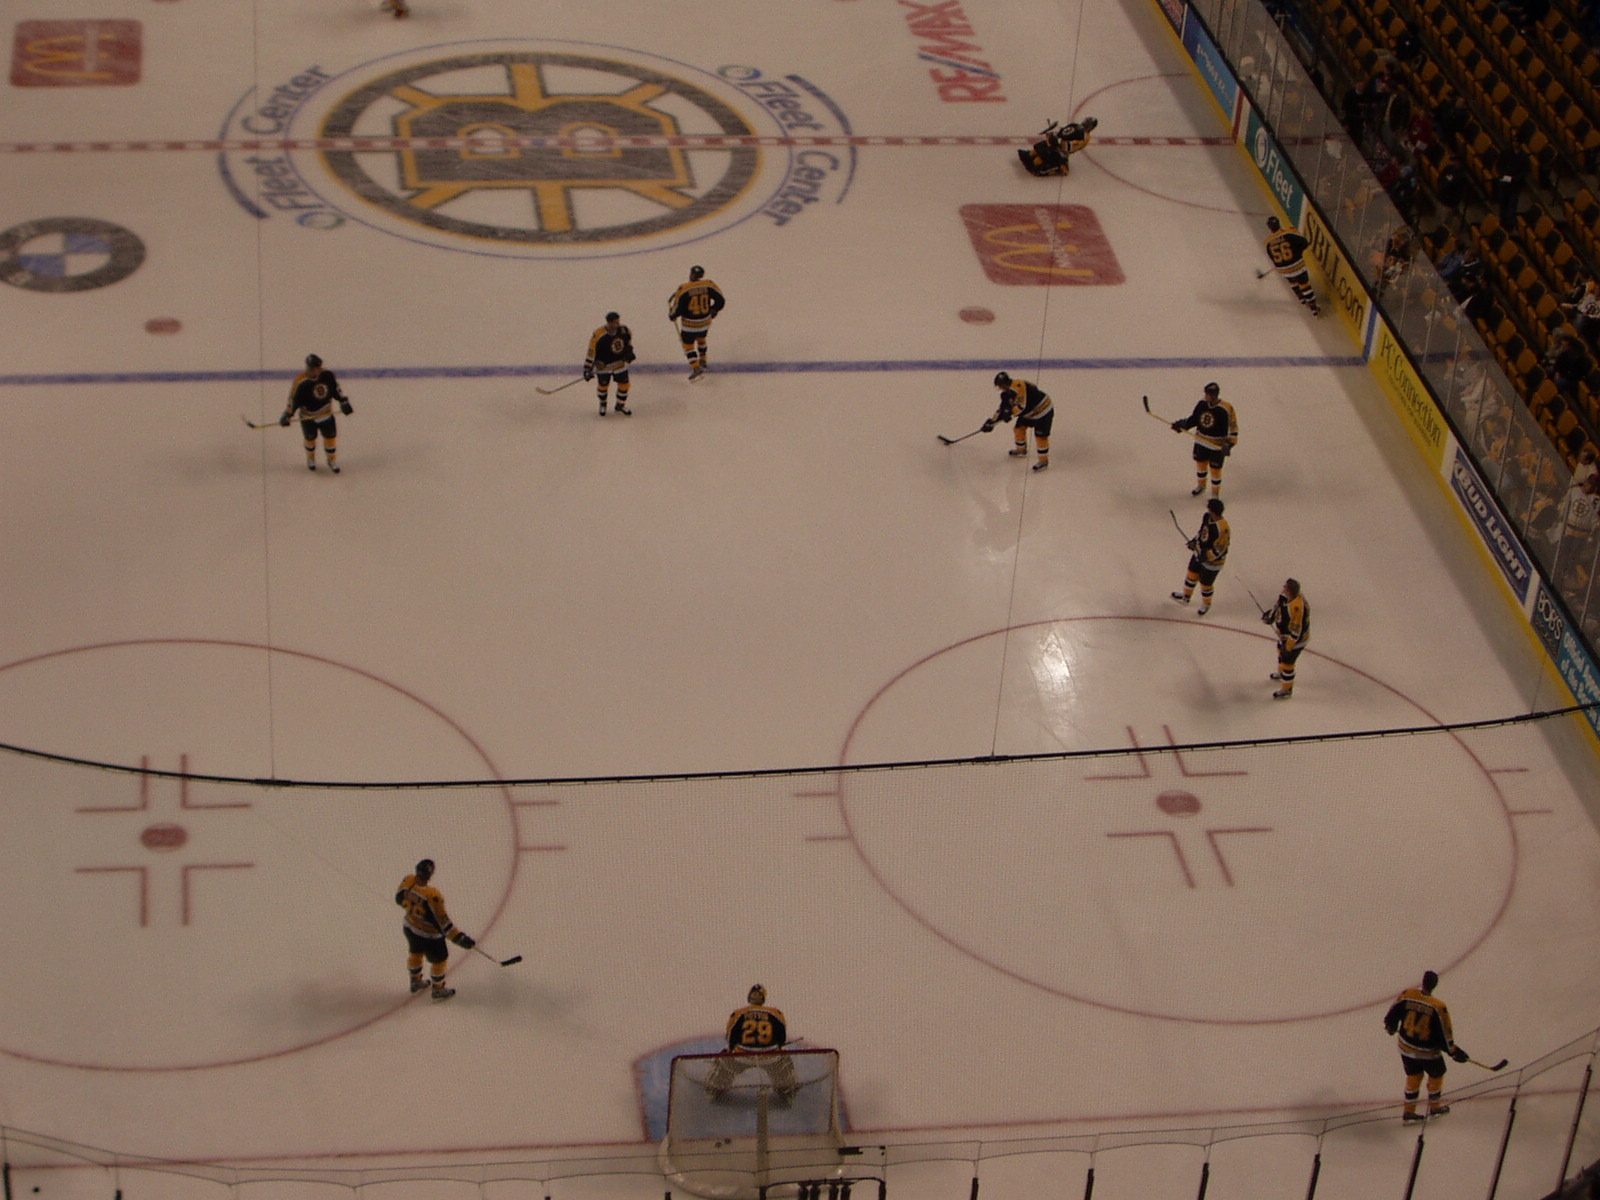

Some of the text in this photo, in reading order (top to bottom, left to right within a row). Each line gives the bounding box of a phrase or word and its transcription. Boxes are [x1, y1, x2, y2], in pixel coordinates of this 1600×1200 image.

[897, 0, 1007, 102] RE/MAX
[241, 65, 331, 210] Fleet Center
[735, 81, 838, 226] Fleet Center
[1266, 148, 1294, 208] Fleet
[1270, 240, 1295, 264] 56
[1304, 211, 1363, 329] SBLI.com
[688, 294, 710, 315] 40
[1393, 354, 1441, 447] Connection
[1457, 466, 1527, 581] BUD LIGHT
[741, 1020, 774, 1045] 29
